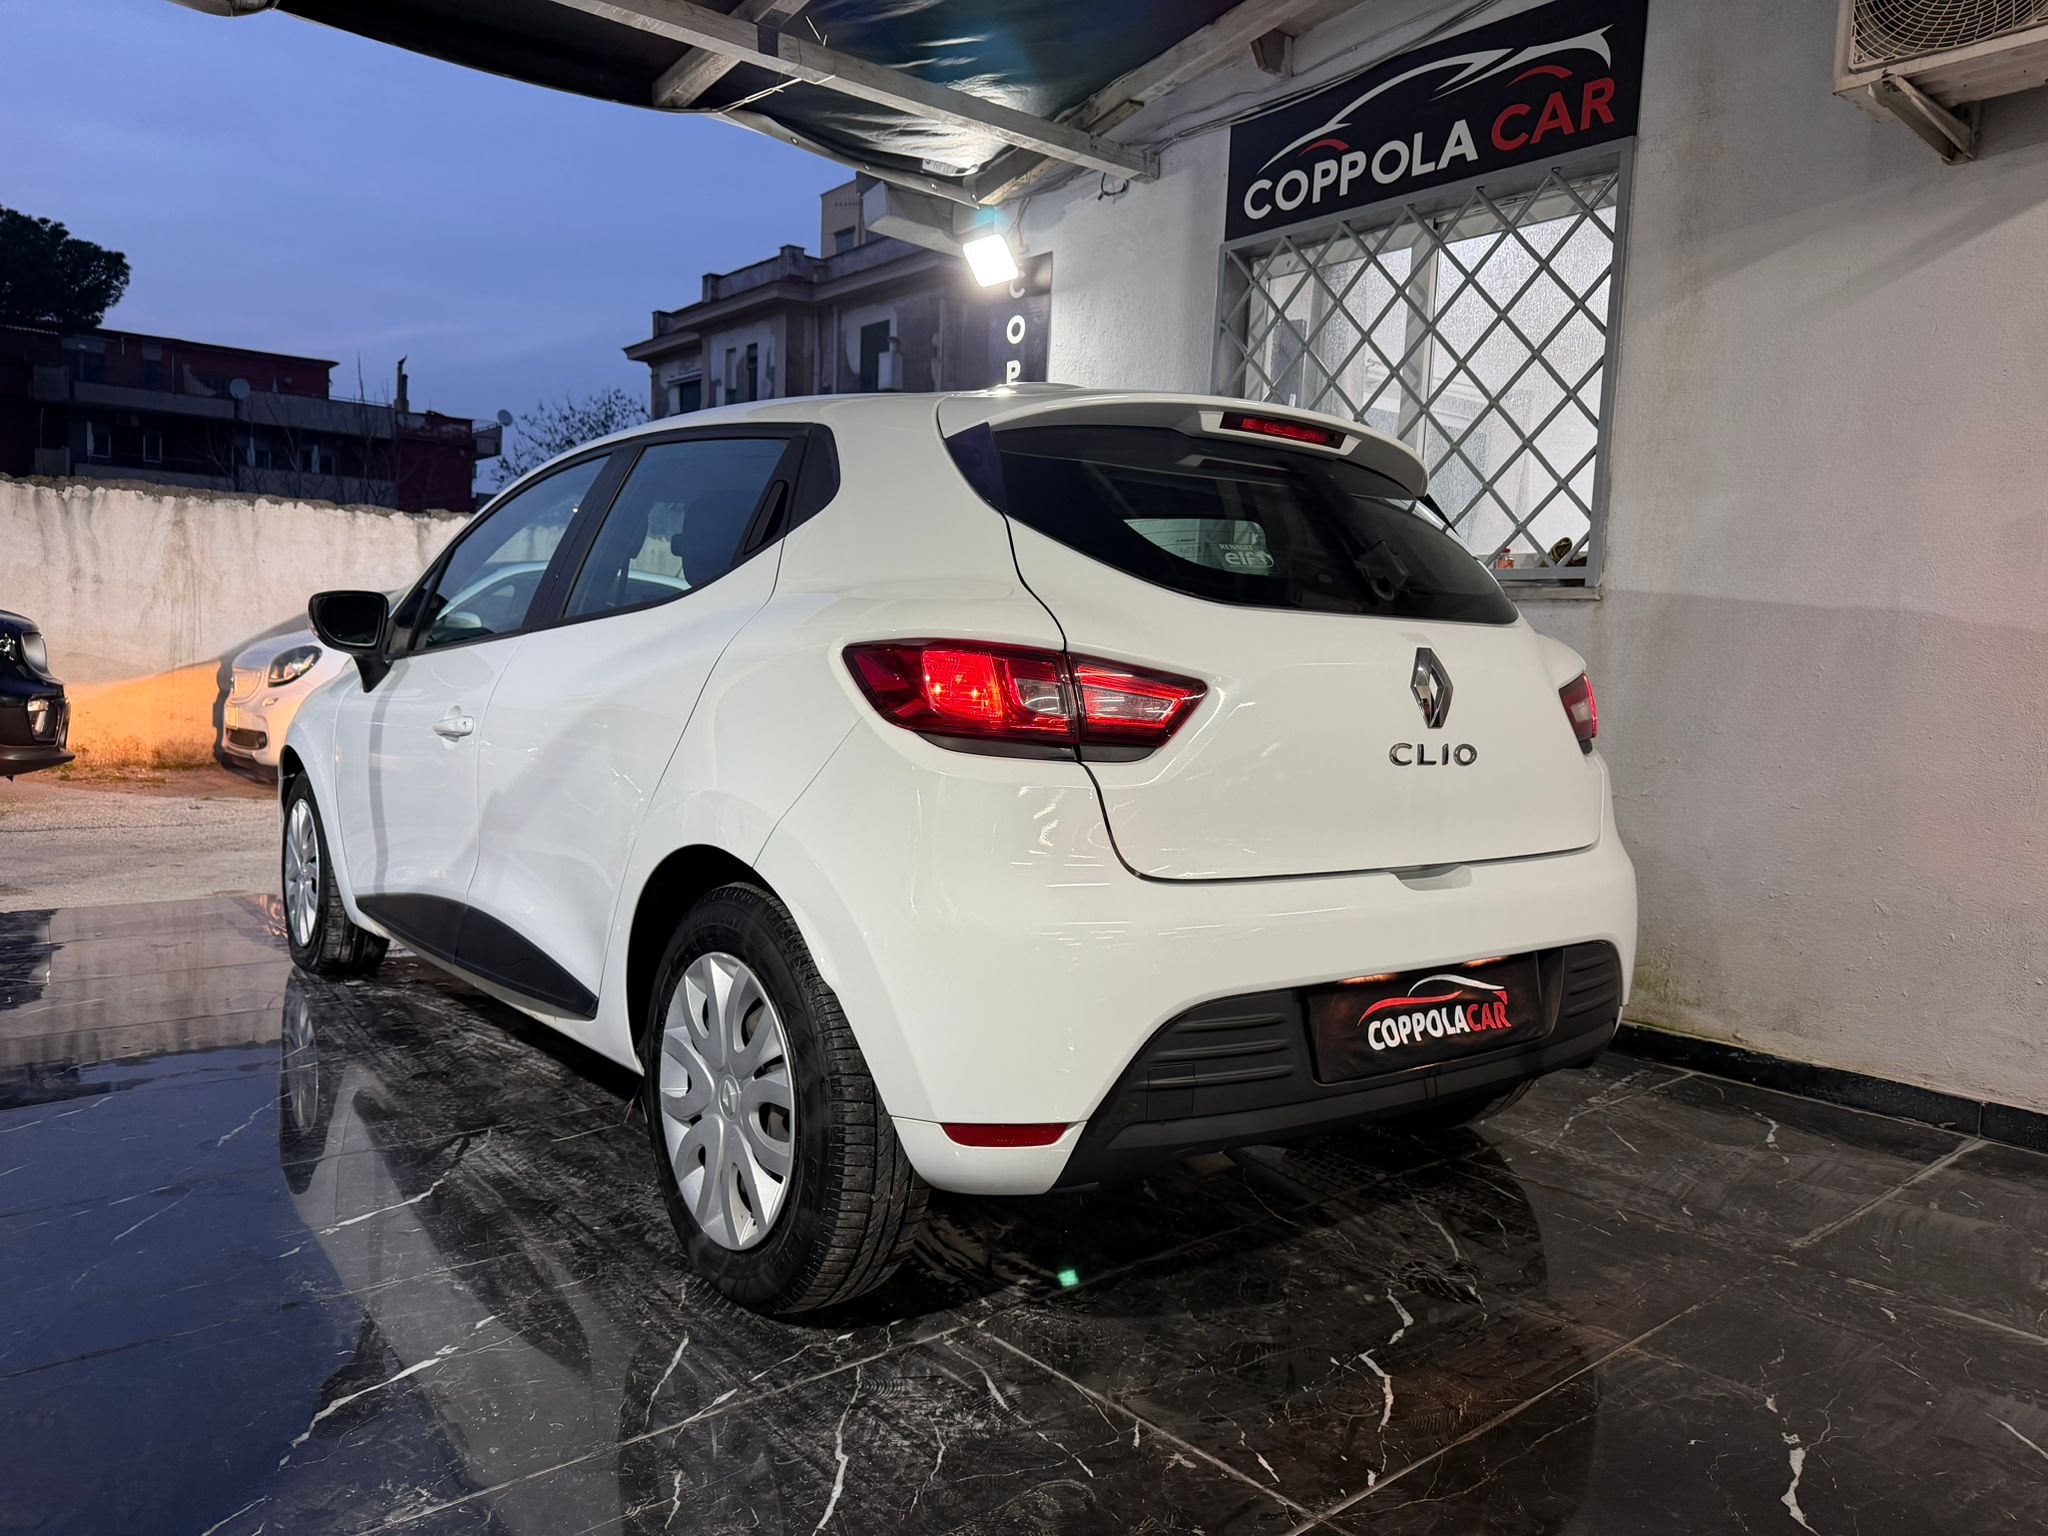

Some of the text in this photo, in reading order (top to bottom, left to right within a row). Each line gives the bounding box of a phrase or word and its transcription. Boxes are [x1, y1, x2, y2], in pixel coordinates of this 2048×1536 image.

[1243, 76, 1615, 220] COPPOLA CAR
[1224, 551, 1255, 565] elf
[1389, 742, 1478, 766] CLIO
